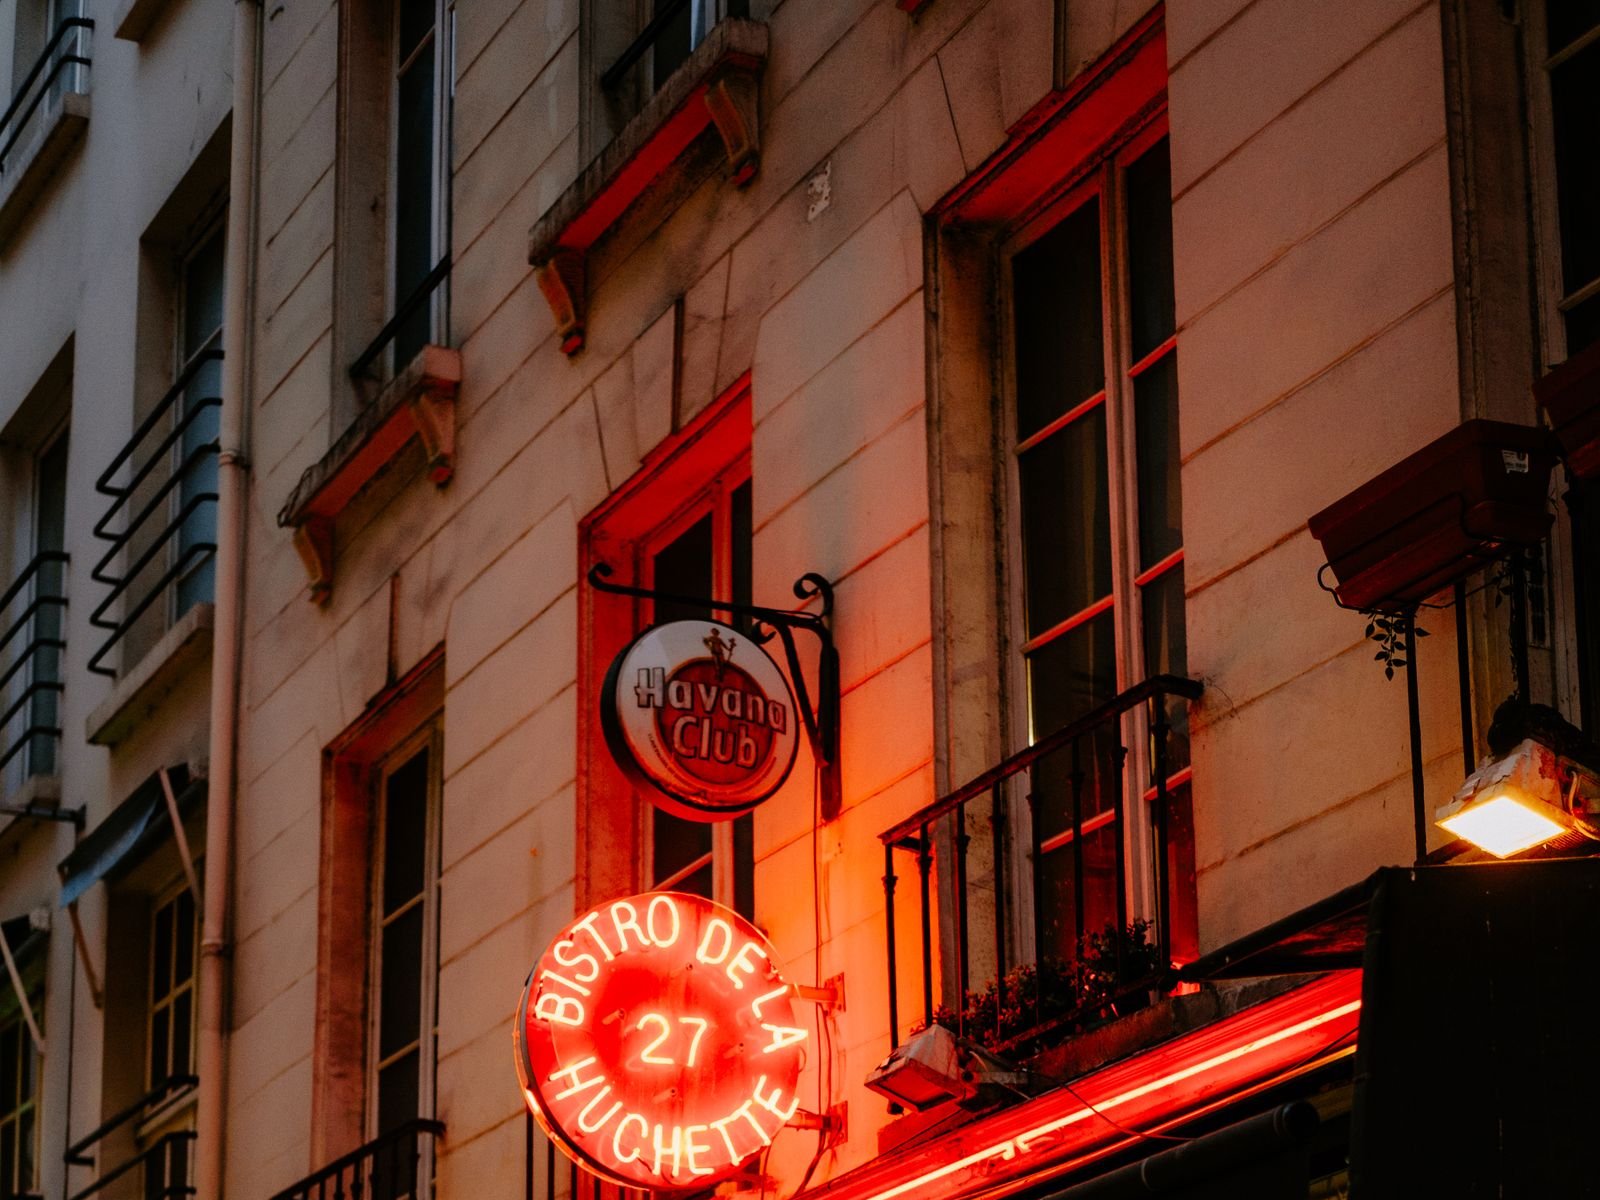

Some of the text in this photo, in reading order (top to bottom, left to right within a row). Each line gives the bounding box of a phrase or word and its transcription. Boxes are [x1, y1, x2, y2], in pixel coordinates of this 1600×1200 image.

[635, 667, 787, 734] Havana
[672, 715, 759, 769] Club
[535, 895, 808, 1055] BISTRO DE LA
[636, 1013, 708, 1068] 27
[549, 1055, 801, 1178] HUCHETTE
